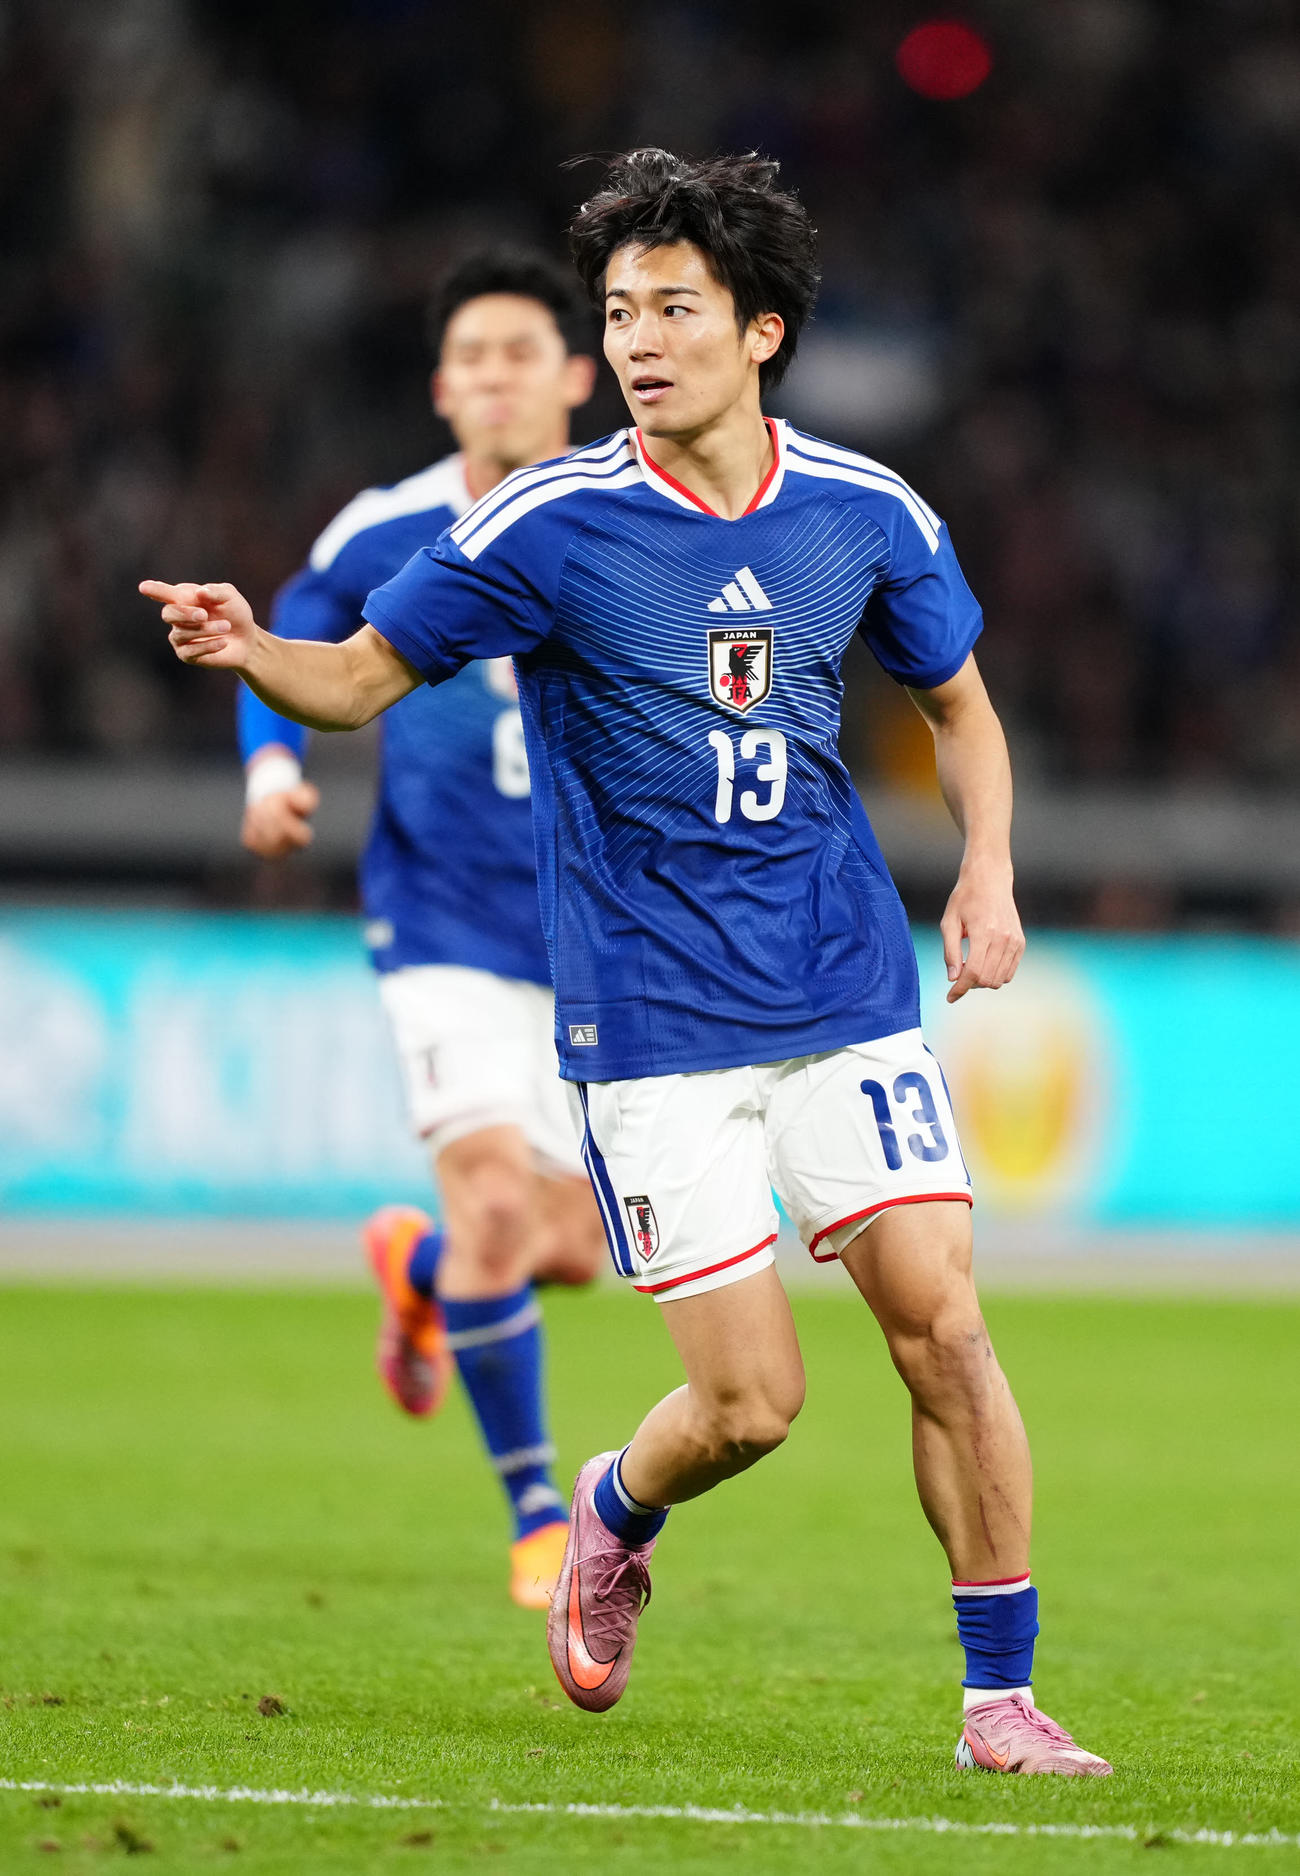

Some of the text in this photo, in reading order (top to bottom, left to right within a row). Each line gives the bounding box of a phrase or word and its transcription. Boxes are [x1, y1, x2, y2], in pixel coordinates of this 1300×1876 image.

[723, 632, 757, 640] JAPAN
[727, 687, 753, 700] JFA
[708, 729, 788, 824] 13
[860, 1071, 949, 1171] 13
